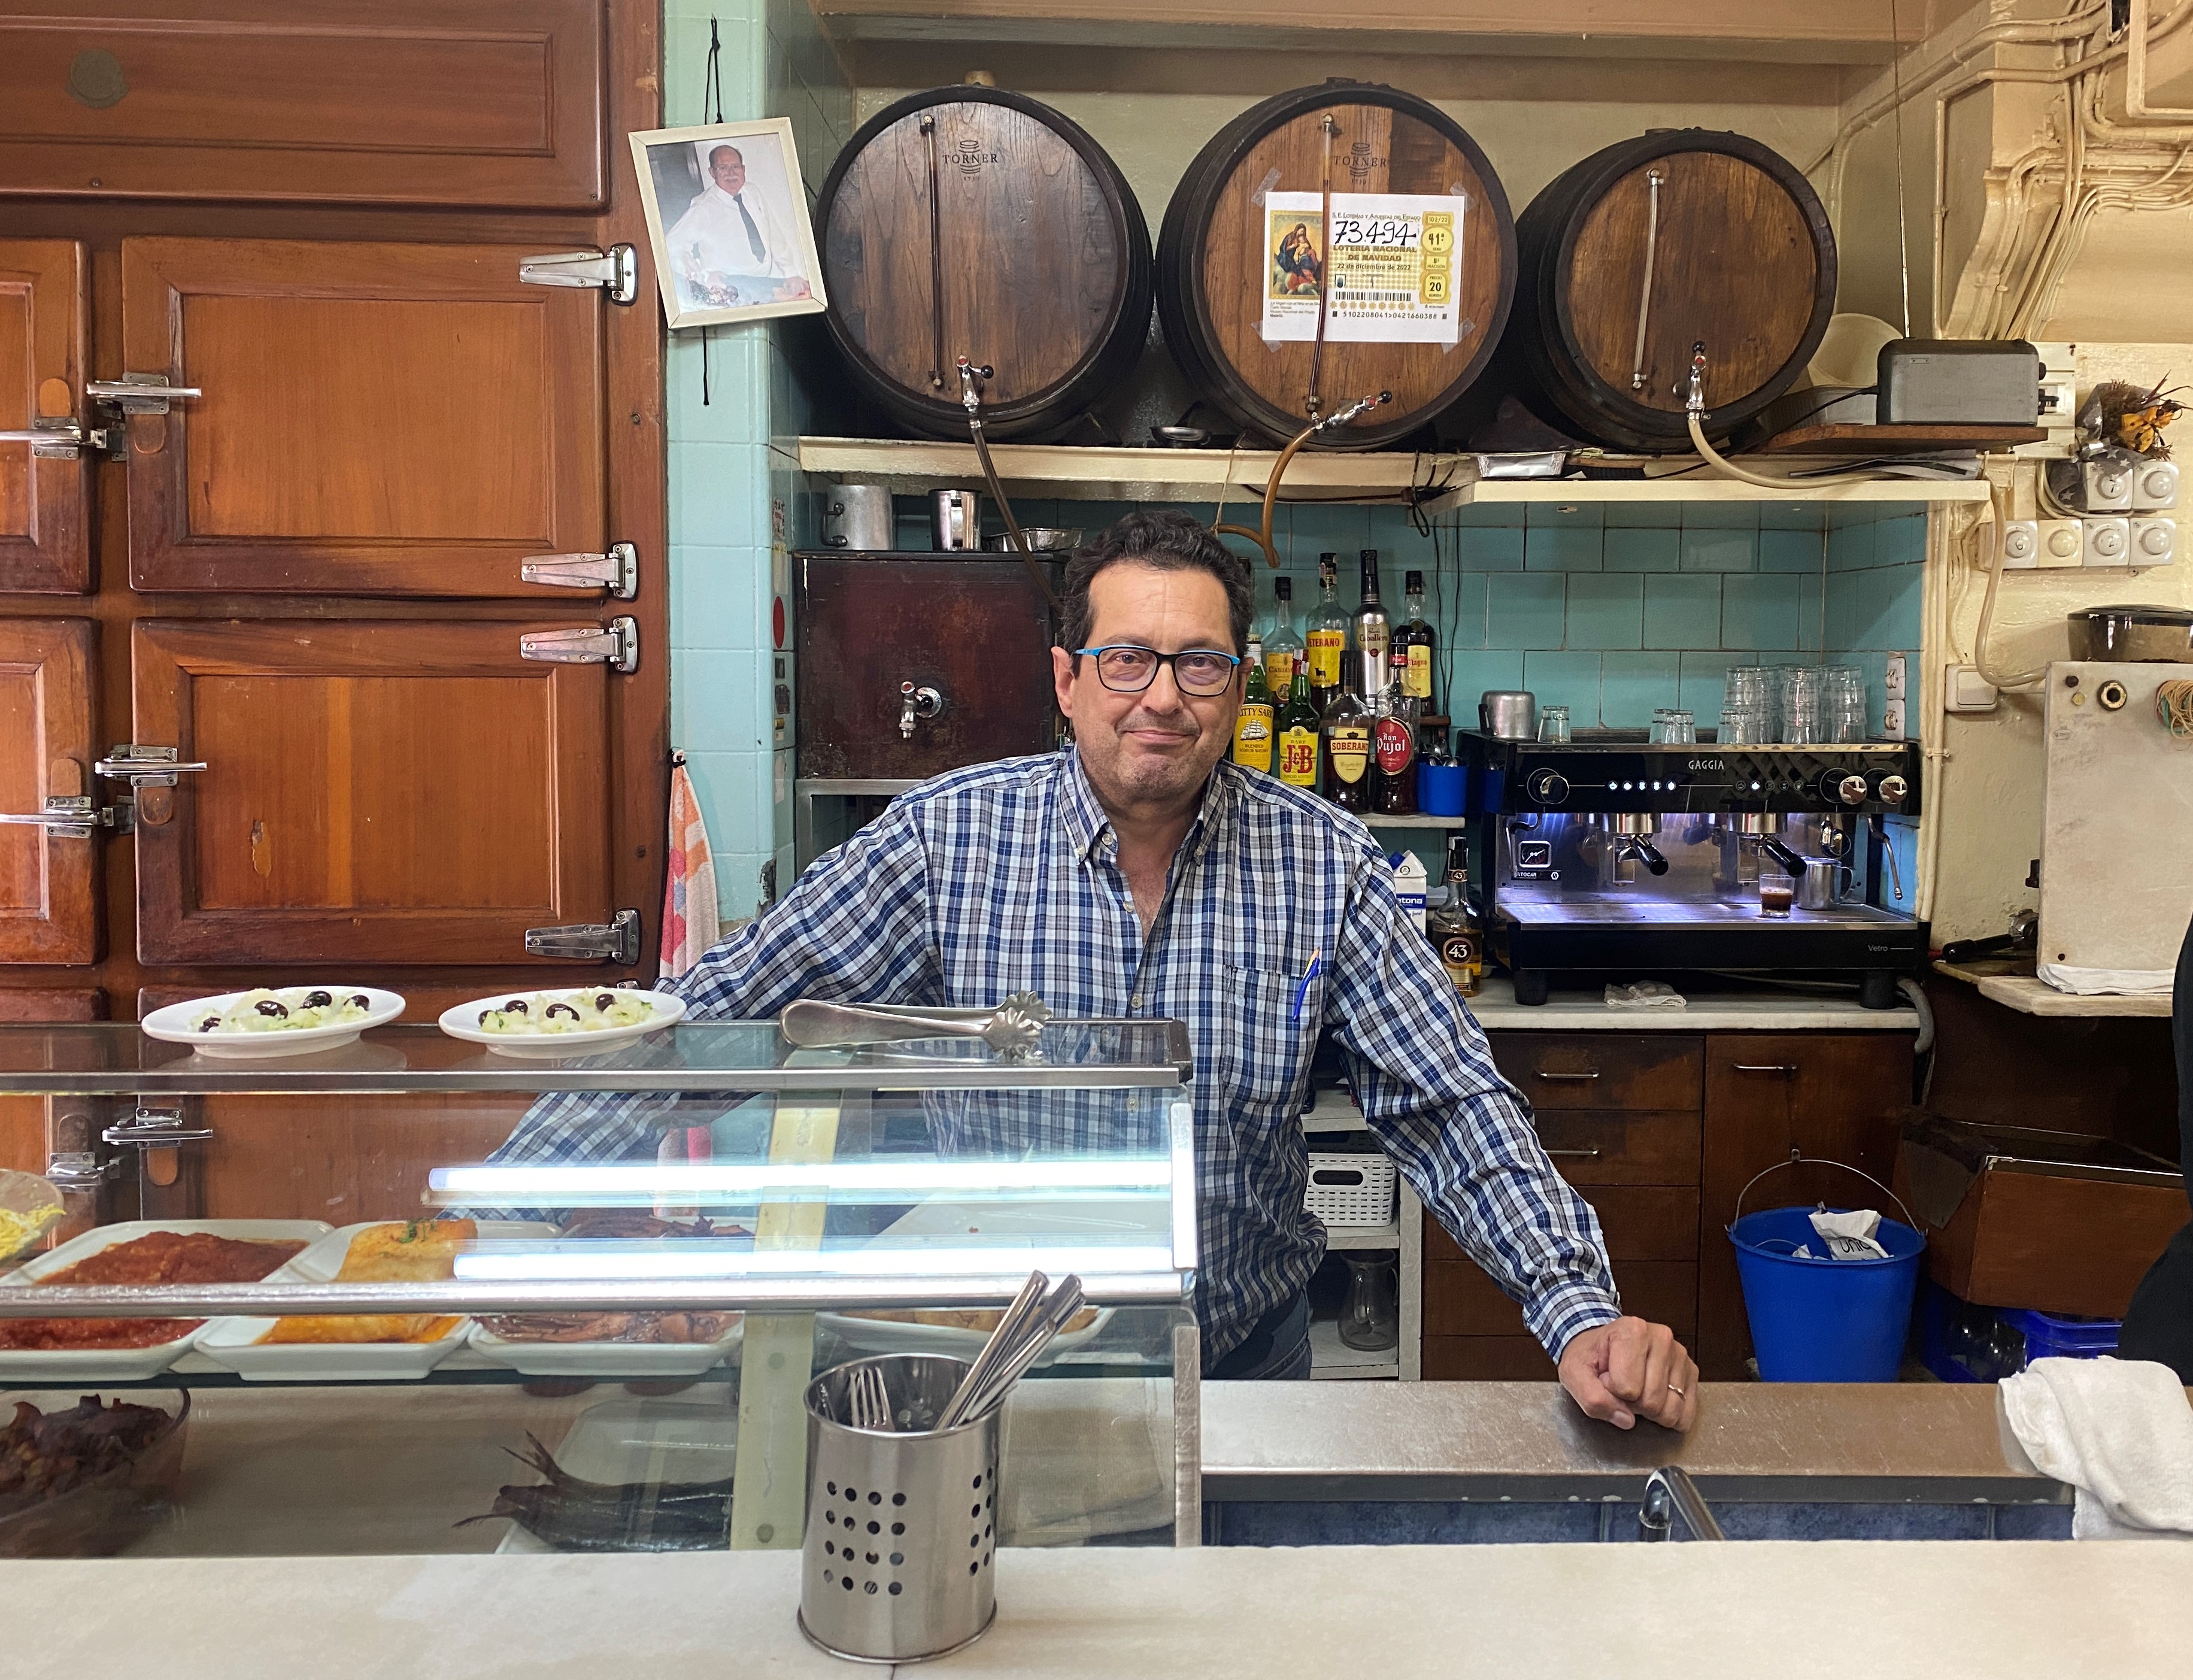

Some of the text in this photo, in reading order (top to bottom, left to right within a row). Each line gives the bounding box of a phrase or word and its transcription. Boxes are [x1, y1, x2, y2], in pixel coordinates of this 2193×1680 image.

[942, 153, 999, 164] TORNER
[1334, 156, 1387, 168] TORNER
[1429, 281, 1442, 292] 20
[1382, 732, 1397, 741] Ron
[1377, 736, 1406, 755] Pujol
[1688, 759, 1724, 770] GAGGIA
[1448, 944, 1468, 959] 43
